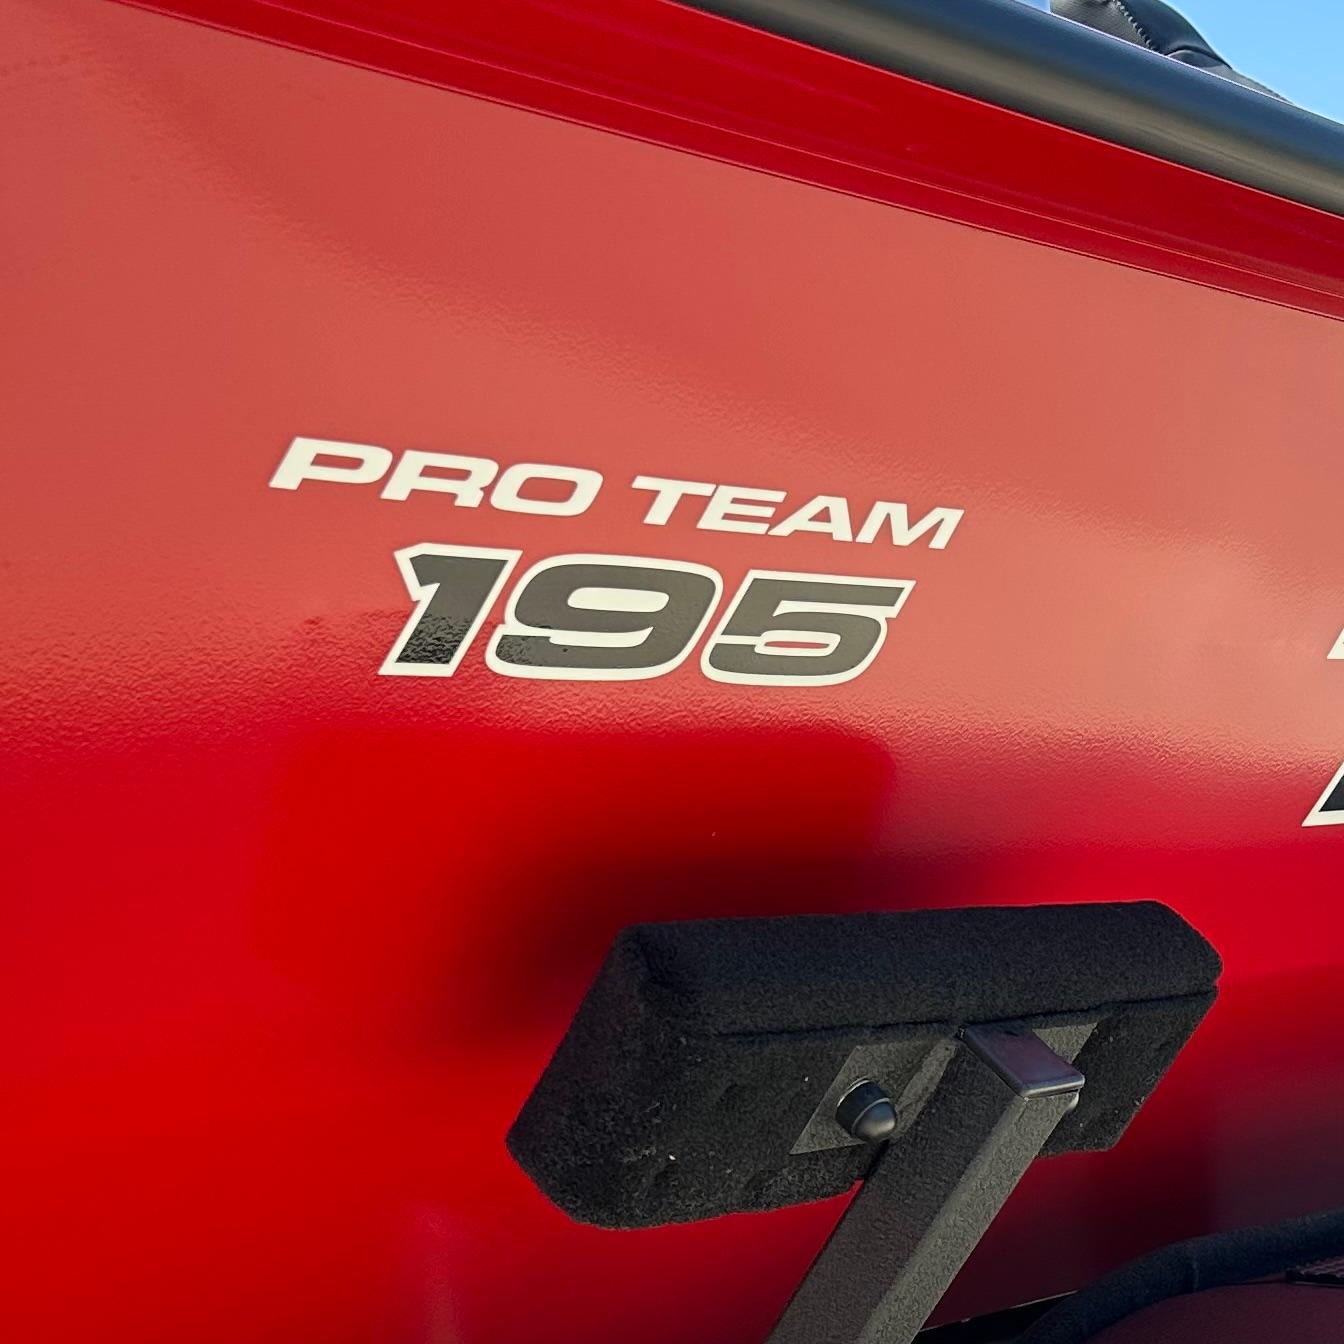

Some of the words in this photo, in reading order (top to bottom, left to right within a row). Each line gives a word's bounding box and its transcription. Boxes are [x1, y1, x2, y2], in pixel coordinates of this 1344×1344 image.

[267, 435, 605, 518] PRO
[631, 473, 965, 551] TEAM
[376, 541, 917, 688] 195
